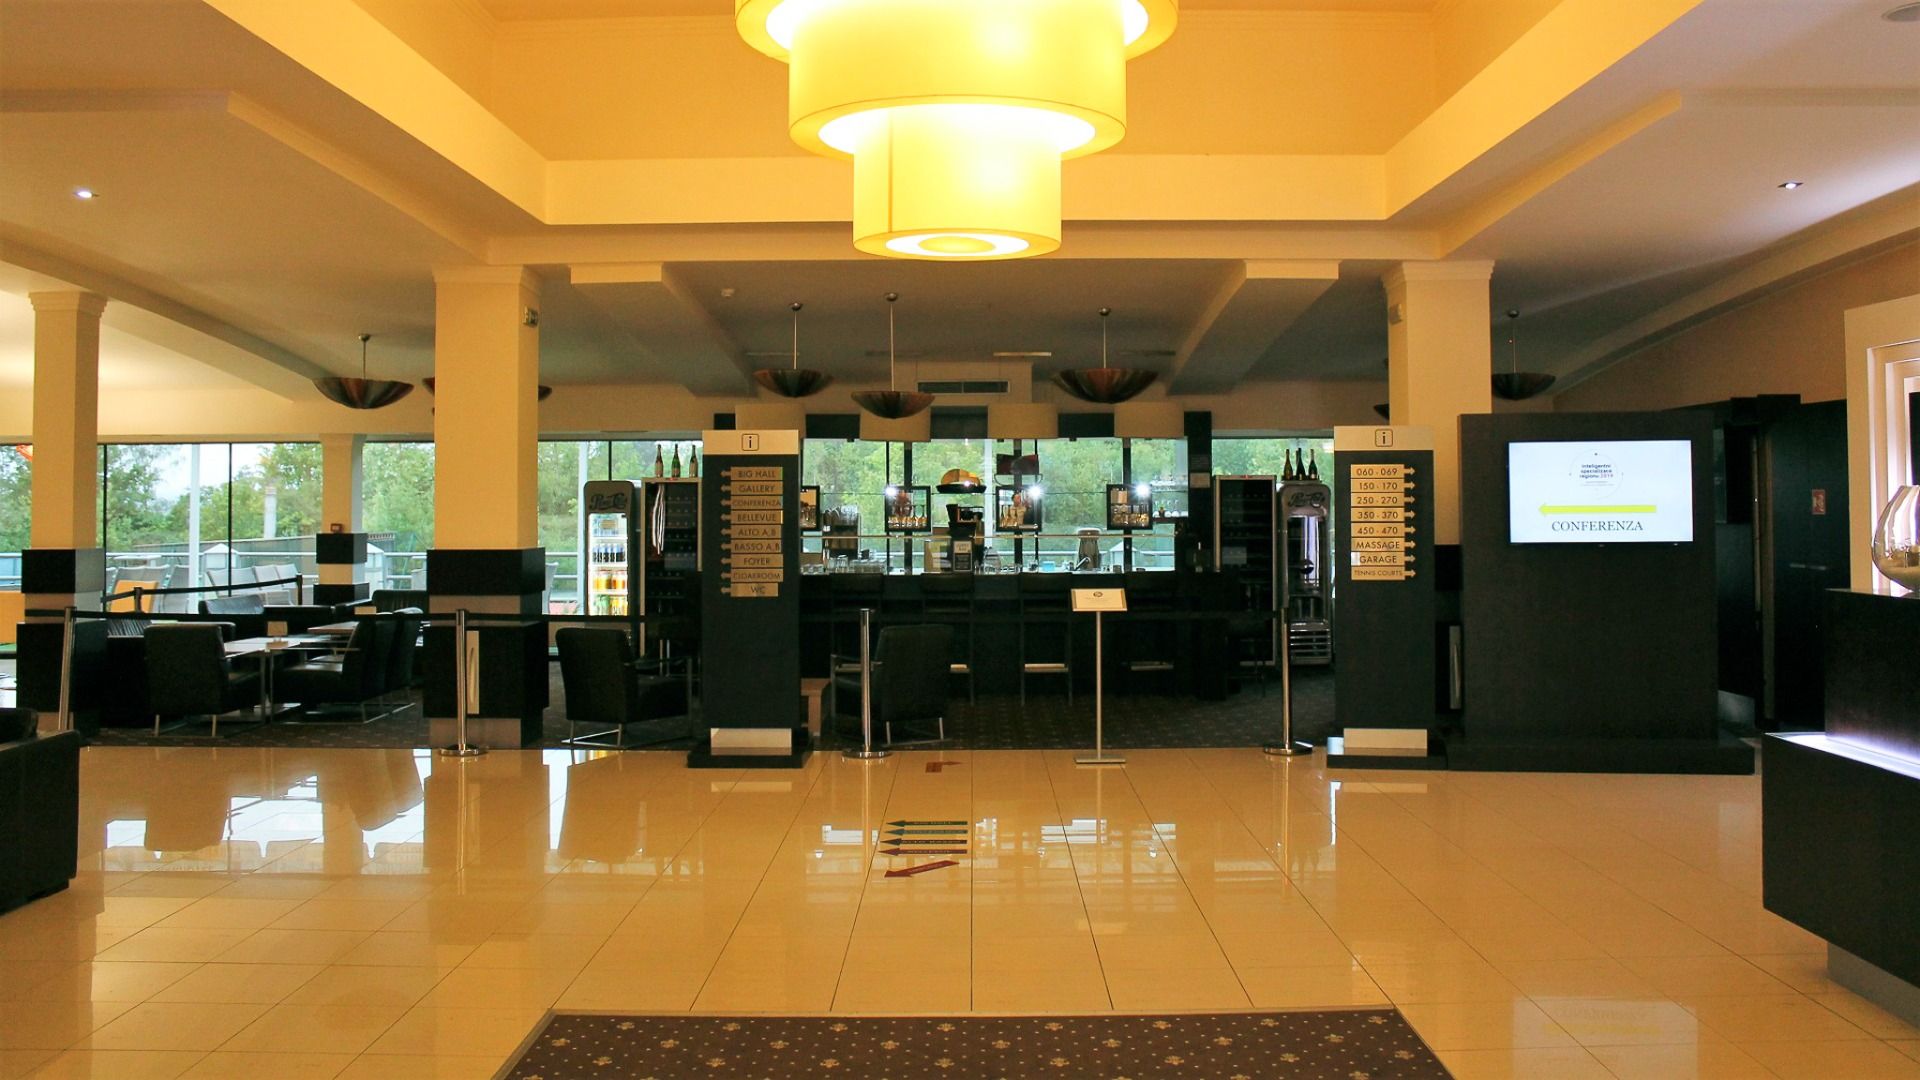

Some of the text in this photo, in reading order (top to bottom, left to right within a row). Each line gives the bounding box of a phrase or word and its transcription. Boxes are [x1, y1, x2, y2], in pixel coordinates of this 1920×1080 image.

[738, 470, 776, 478] BIG HALL
[1356, 468, 1374, 476] 060
[1380, 468, 1397, 476] 069
[738, 485, 775, 493] GALLERY
[1359, 482, 1375, 490] 150
[1382, 482, 1398, 490] 170
[1357, 496, 1374, 504] 250
[1381, 496, 1398, 504] 270
[737, 513, 776, 521] BELLEVUE
[1357, 511, 1375, 519] 350
[1381, 511, 1398, 519] 370
[1357, 526, 1375, 534] 450
[1381, 526, 1398, 534] 470
[1551, 521, 1643, 531] CONFERENZA
[738, 529, 760, 537] ALTO
[734, 543, 763, 551] BASSO
[1356, 541, 1400, 549] MASSAGE
[743, 557, 770, 566] FOYER
[1360, 555, 1397, 563] GARAGE
[733, 572, 781, 580] CLOAKROOM
[750, 586, 766, 594] WC
